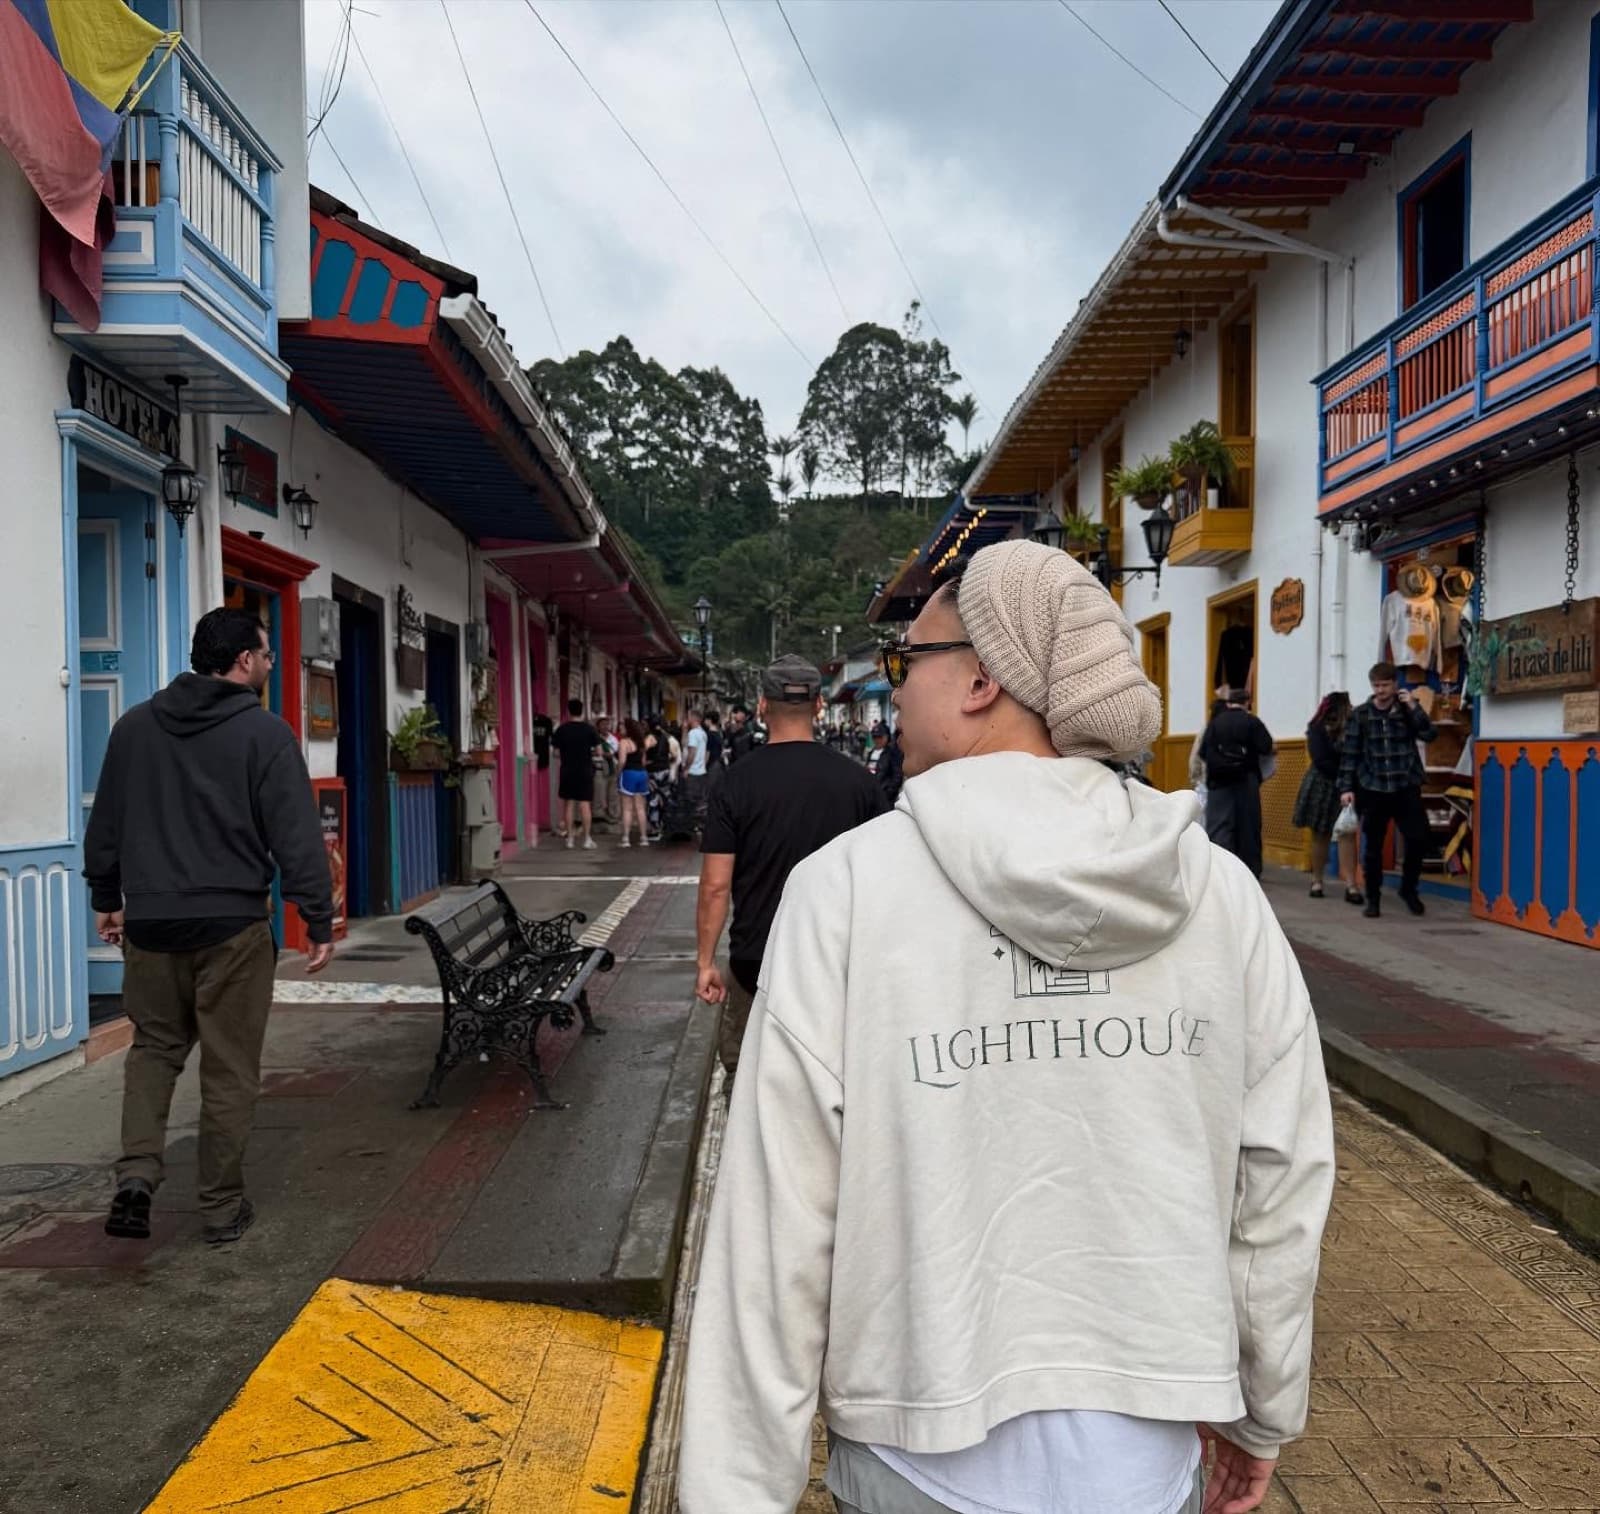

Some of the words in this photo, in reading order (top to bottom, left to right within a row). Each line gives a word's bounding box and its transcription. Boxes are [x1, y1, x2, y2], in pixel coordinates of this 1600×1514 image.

[83, 366, 165, 451] HOTEL
[1523, 652, 1550, 678] casa
[1553, 638, 1569, 673] de
[1571, 634, 1591, 672] lili
[908, 1007, 1210, 1089] LIGHTHOUSE
